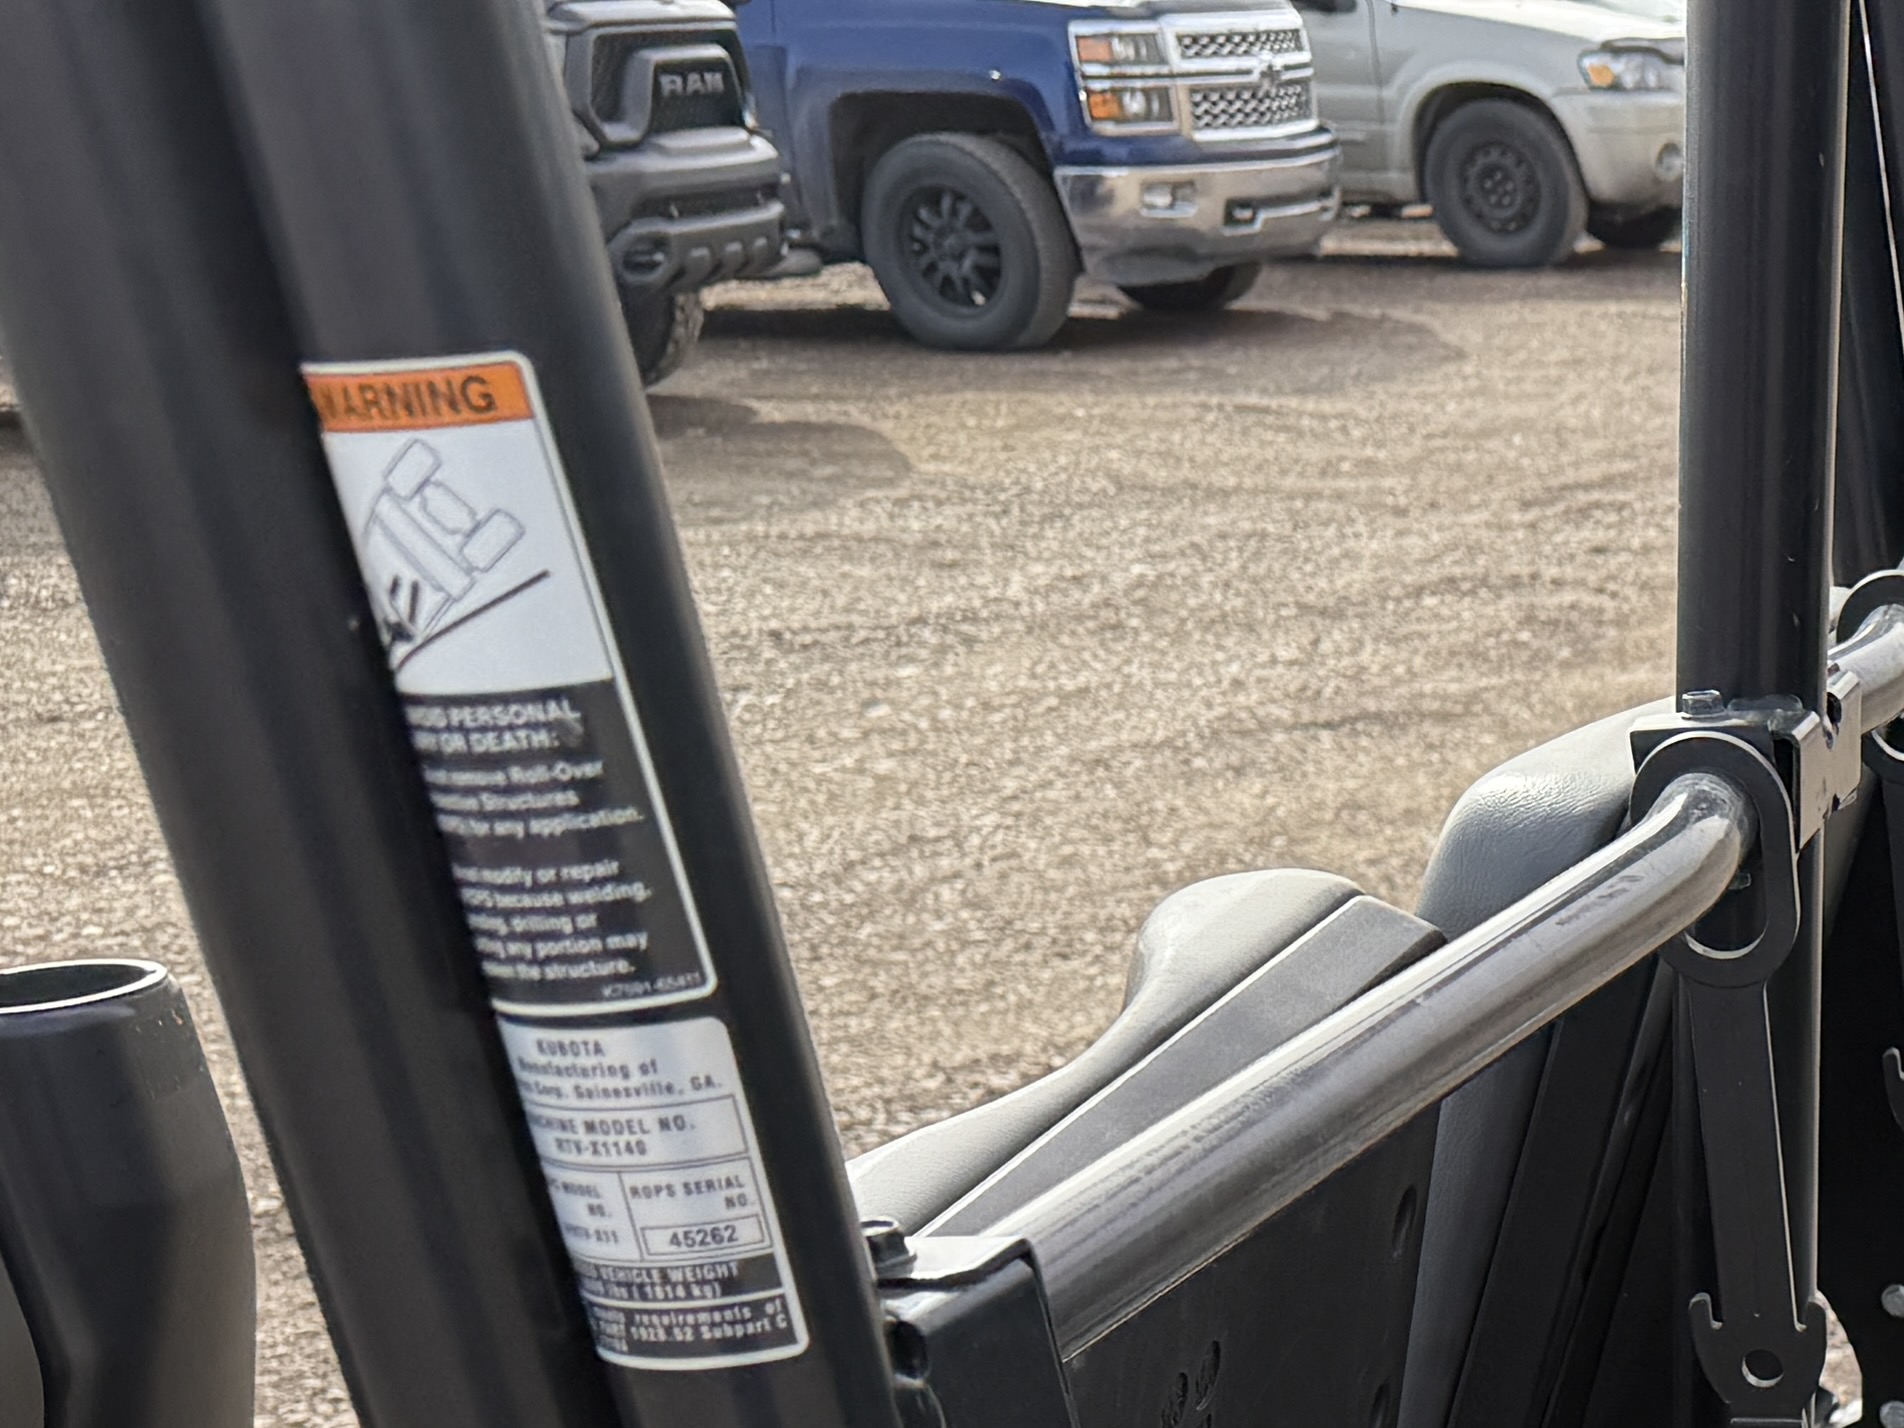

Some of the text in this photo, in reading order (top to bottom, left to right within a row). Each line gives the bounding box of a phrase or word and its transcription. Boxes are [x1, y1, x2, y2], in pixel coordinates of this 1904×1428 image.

[659, 71, 725, 97] RAM
[448, 697, 580, 728] PERSONAL
[561, 860, 619, 884] repair
[607, 931, 648, 952] may
[537, 1039, 606, 1057] KUBOTA
[639, 1059, 658, 1075] of
[584, 1119, 650, 1136] MODEL
[658, 1115, 696, 1132] NO.
[629, 1176, 745, 1200] ROPS SERIAL
[668, 1224, 739, 1248] 45262
[668, 1262, 739, 1279] WEIGHT
